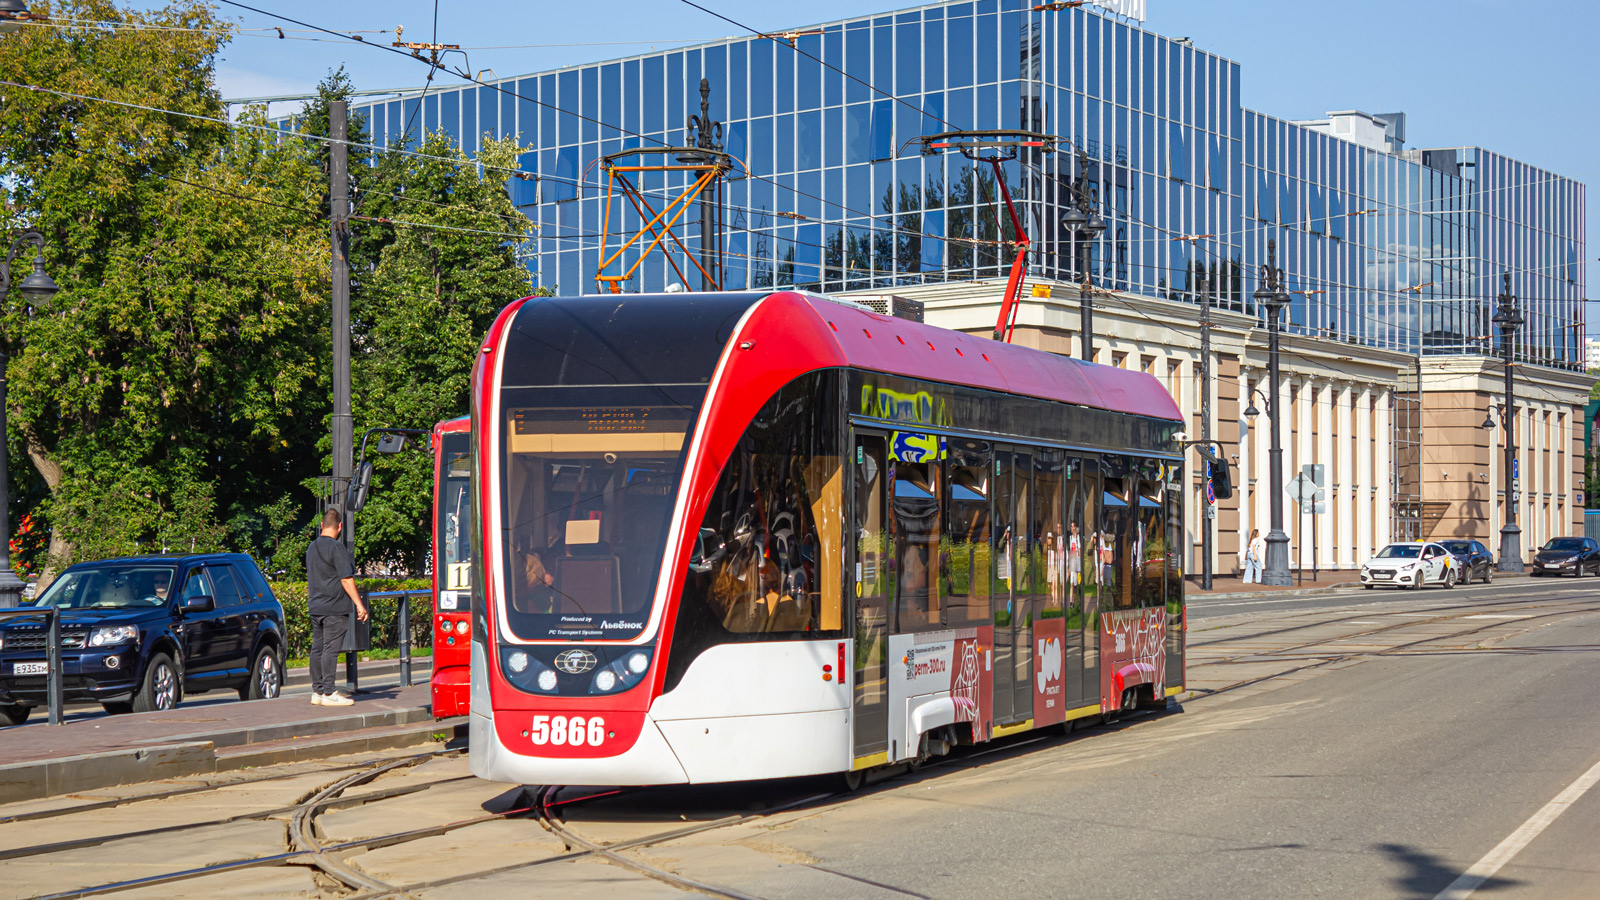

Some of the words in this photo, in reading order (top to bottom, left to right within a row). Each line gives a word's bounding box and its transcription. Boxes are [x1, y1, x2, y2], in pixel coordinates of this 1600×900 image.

[600, 619, 643, 630] Львёнок
[914, 657, 946, 680] perm-300.ru
[531, 714, 605, 747] 5866
